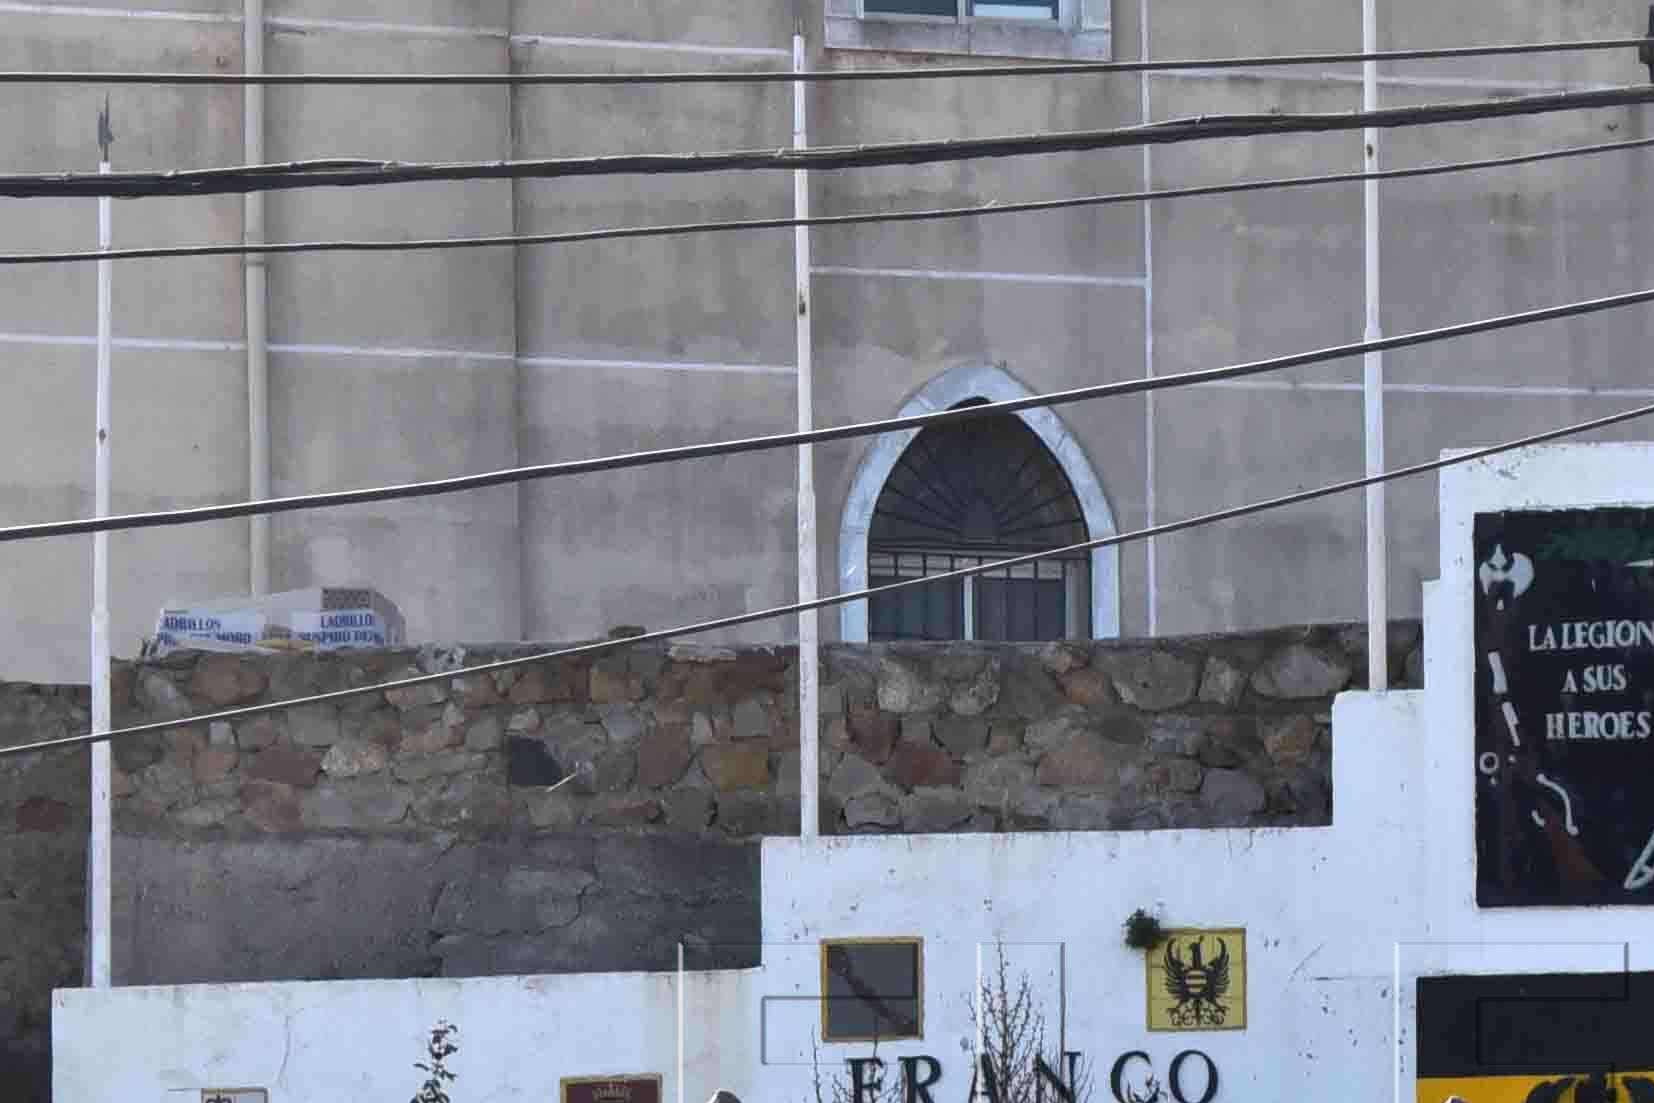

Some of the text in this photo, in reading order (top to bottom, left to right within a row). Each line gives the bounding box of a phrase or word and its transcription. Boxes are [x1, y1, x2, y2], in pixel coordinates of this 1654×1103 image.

[1528, 624, 1562, 652] LA
[1561, 664, 1628, 694] A SUS
[1544, 711, 1653, 740] HEROES
